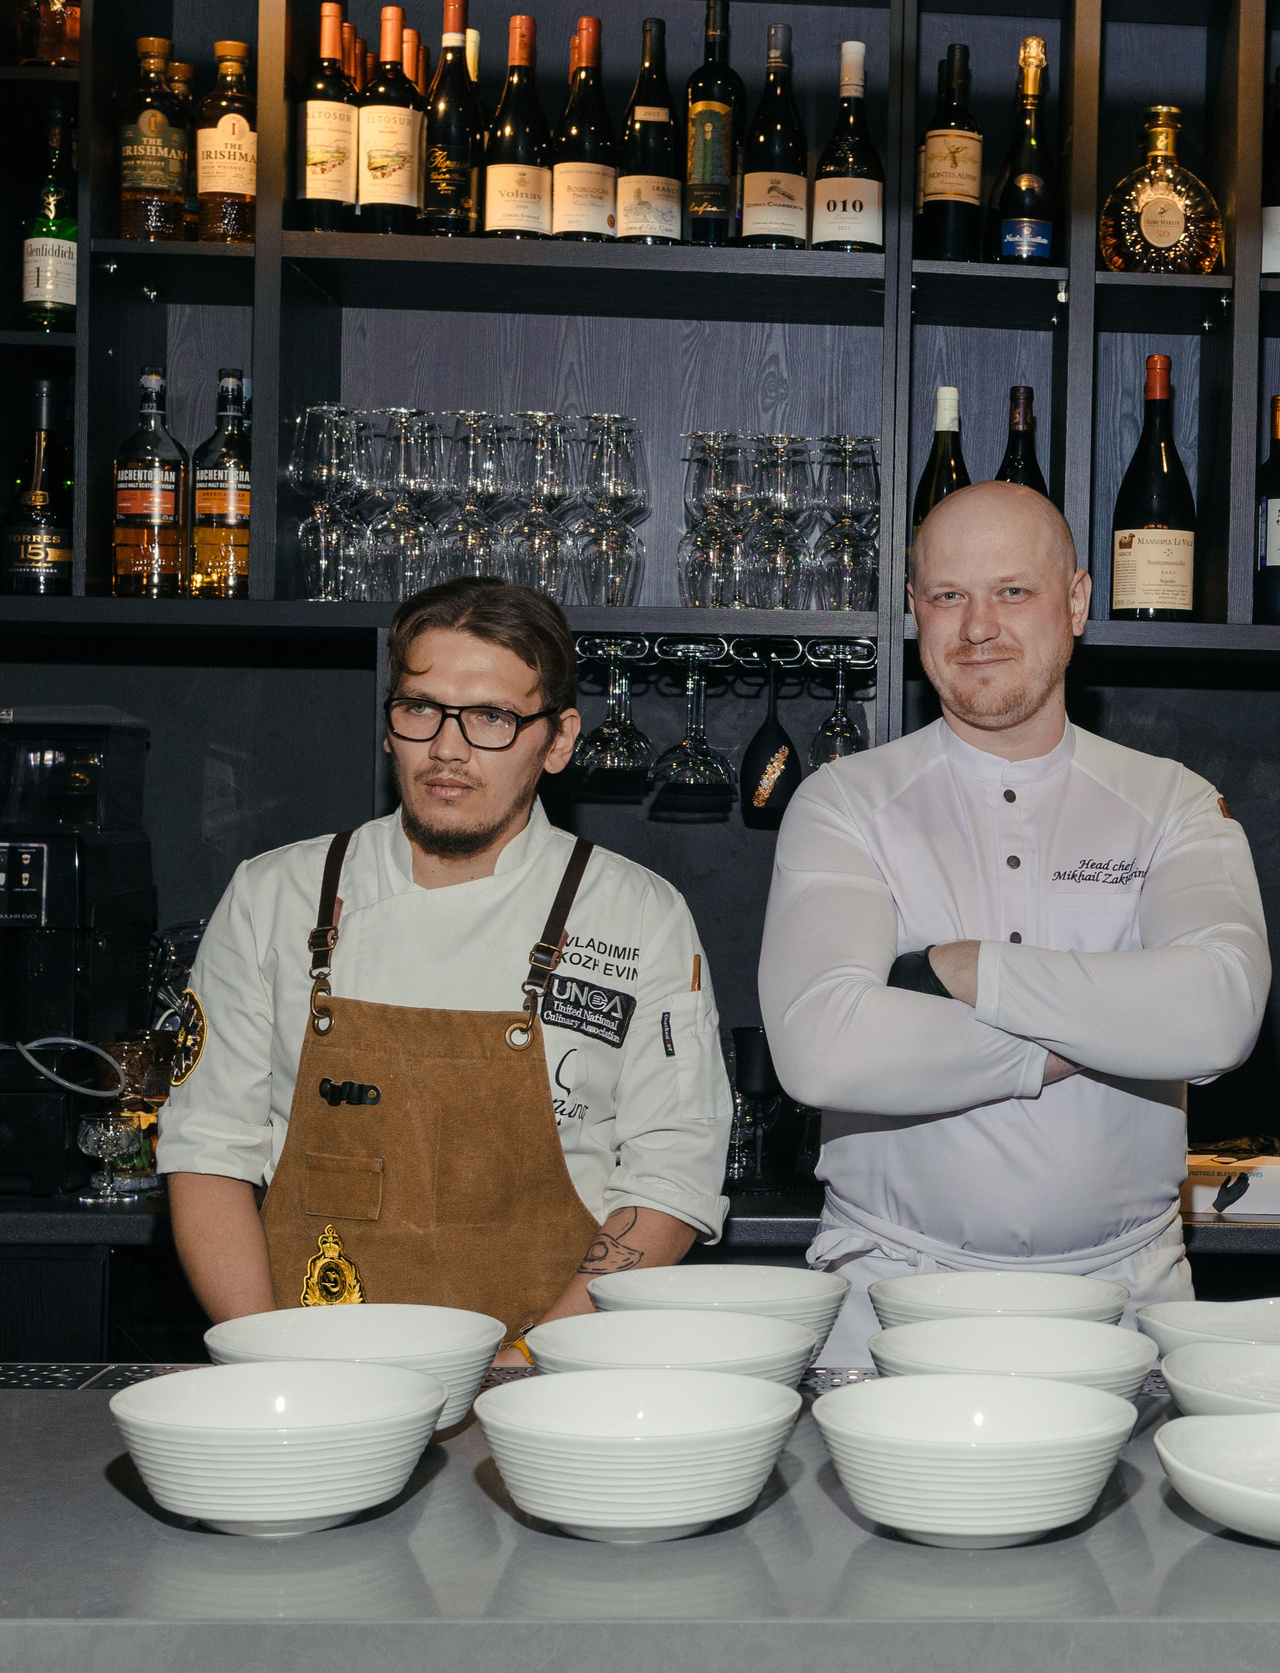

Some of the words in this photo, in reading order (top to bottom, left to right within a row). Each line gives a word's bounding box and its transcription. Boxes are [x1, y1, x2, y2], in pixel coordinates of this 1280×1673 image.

[366, 115, 413, 127] ALTOSUR
[142, 138, 163, 146] THE
[223, 142, 243, 151] THE
[122, 145, 185, 160] IRISHMAN
[927, 171, 955, 179] MONTES
[957, 171, 977, 181] ALPHA
[498, 189, 543, 202] Volnay
[826, 199, 864, 213] 010
[1156, 230, 1170, 238] XO
[26, 243, 75, 261] Glenfiddich
[117, 469, 176, 482] AUCHENTOHAN
[8, 534, 61, 543] TORRES
[1137, 537, 1172, 546] MASSERIA
[20, 543, 45, 560] 15
[1078, 859, 1113, 871] Head
[1112, 857, 1137, 874] chef
[1052, 870, 1103, 883] Mikhail
[565, 936, 640, 961] VLADIMIR
[553, 1000, 583, 1019] United
[583, 1008, 620, 1031] National
[543, 1010, 581, 1029] Culinary
[580, 1021, 621, 1043] Association
